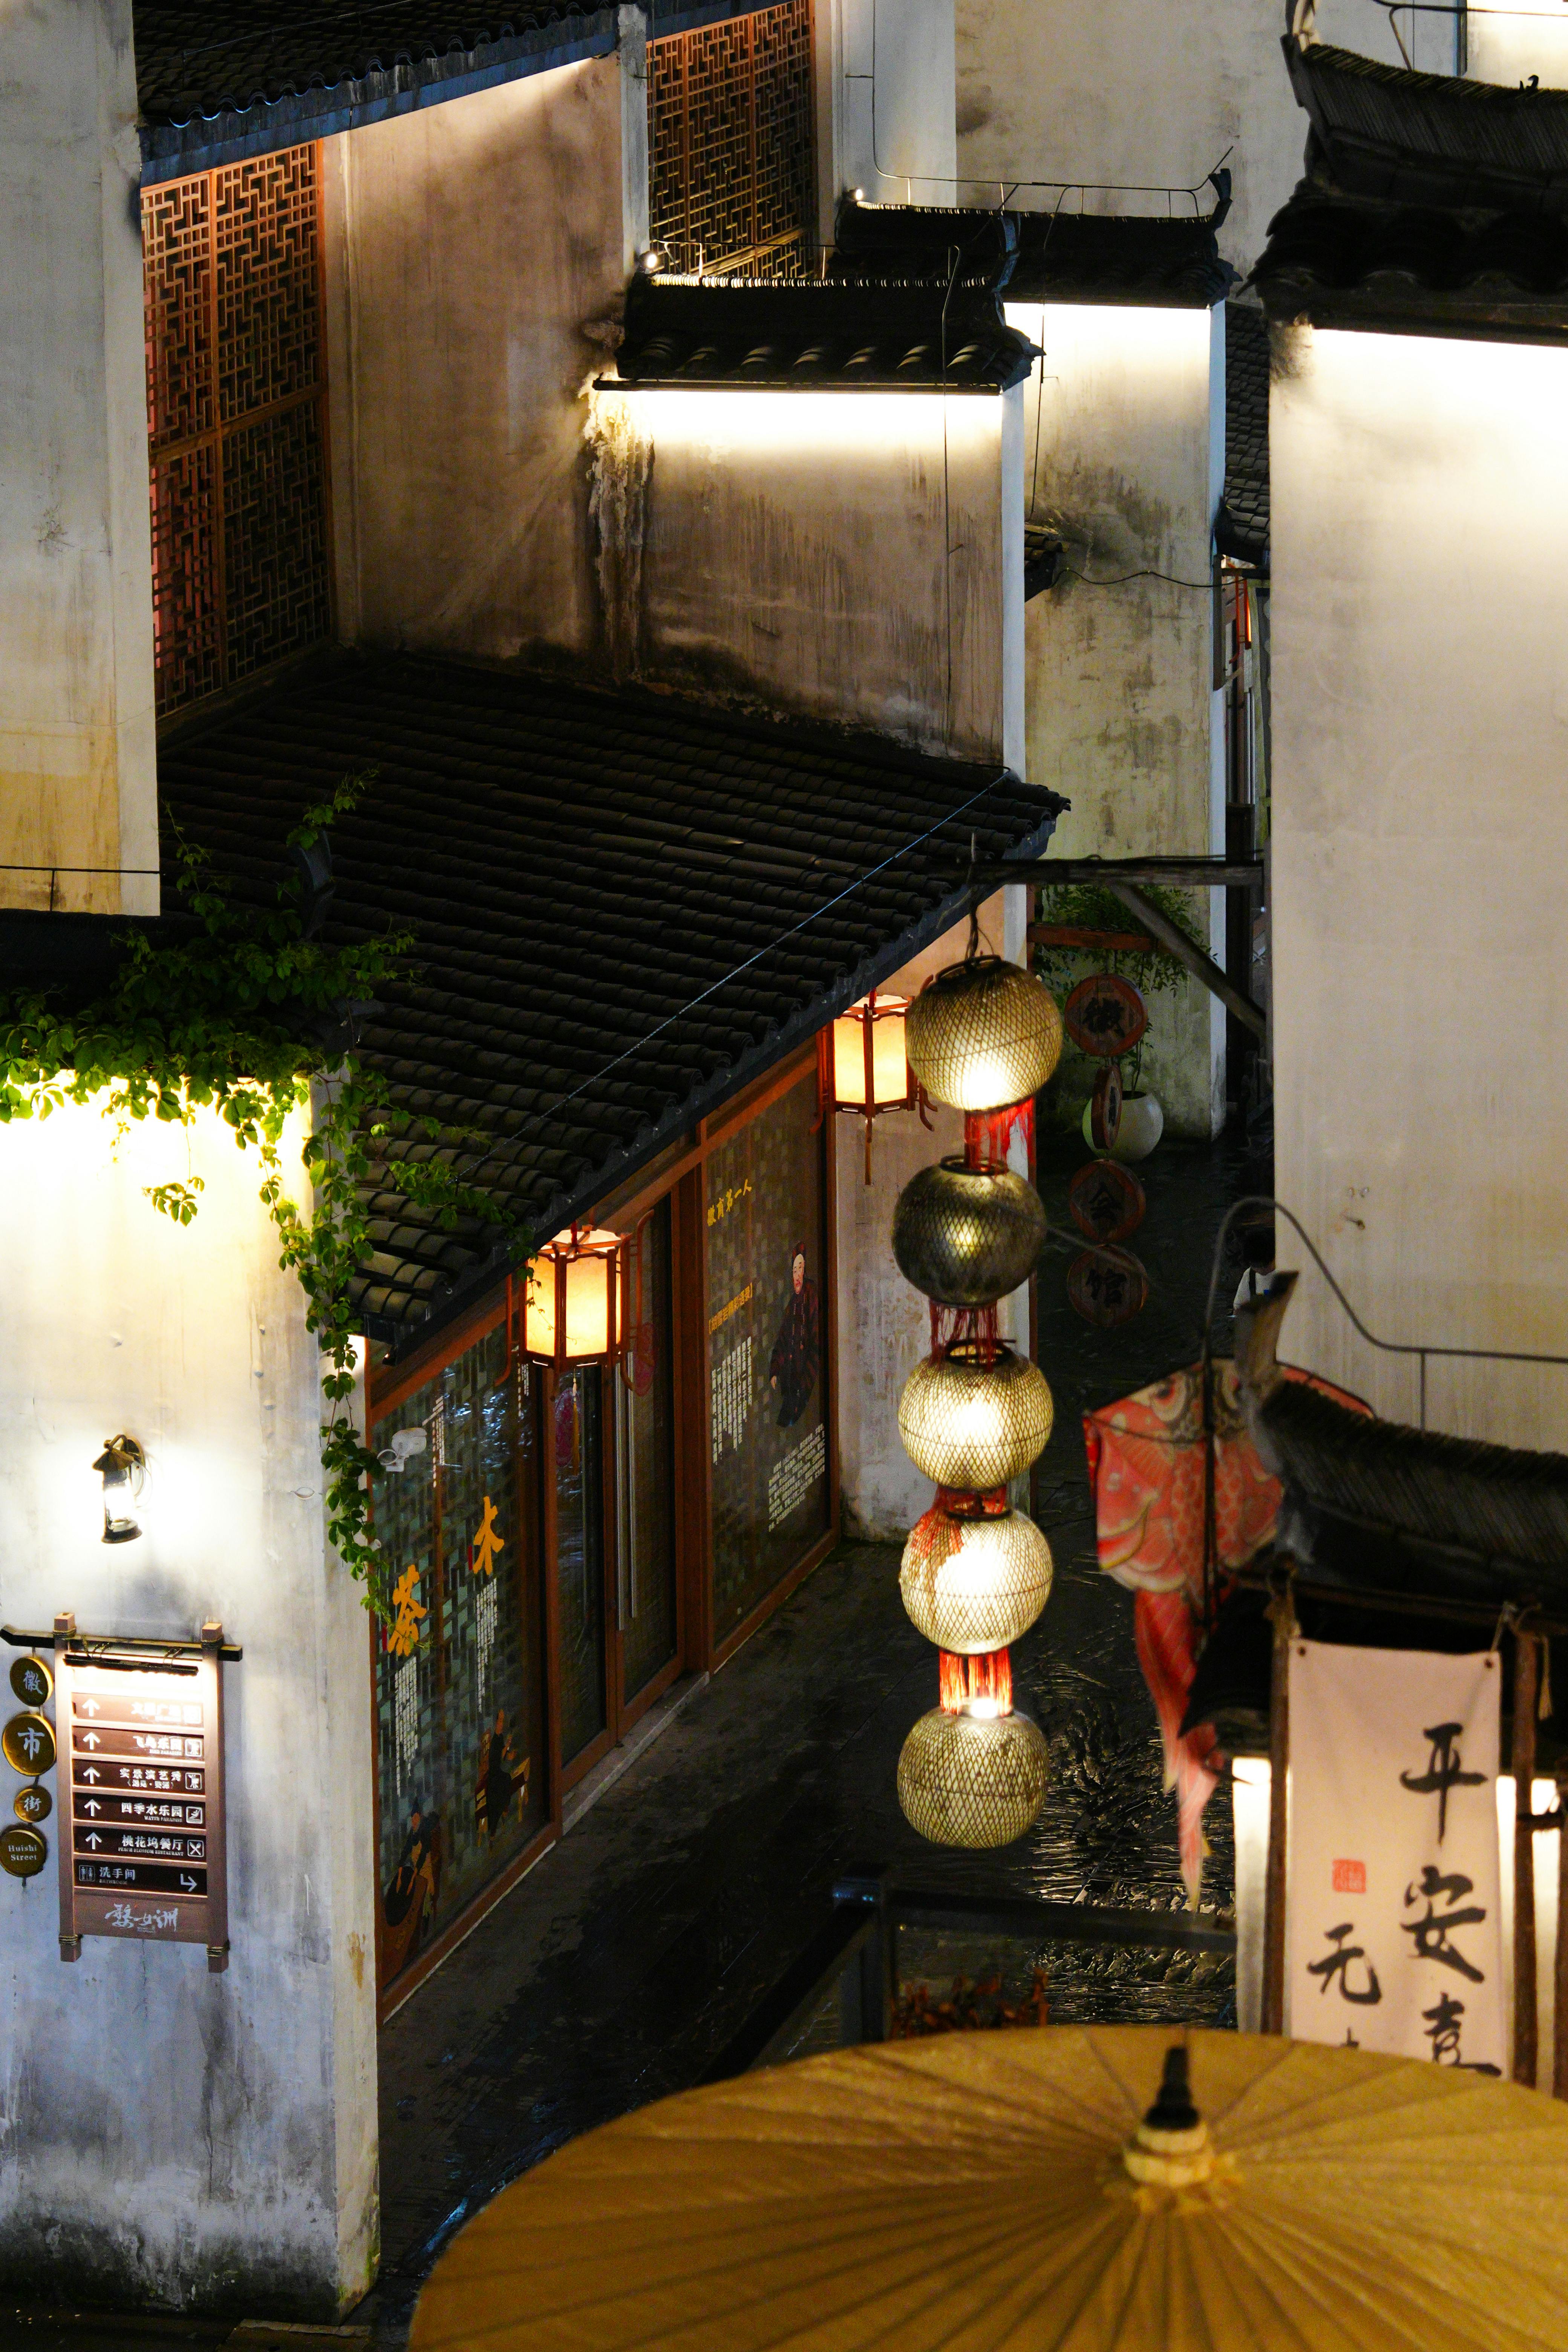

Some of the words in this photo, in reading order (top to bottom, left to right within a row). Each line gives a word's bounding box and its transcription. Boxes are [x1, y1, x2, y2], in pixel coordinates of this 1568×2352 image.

[387, 1564, 427, 1656] 茶
[119, 1767, 181, 1781] 实景演艺秀
[121, 1802, 182, 1817] 四季水乐园
[121, 1834, 183, 1851] 桃花坞餐厅
[99, 1866, 136, 1880] 洗手间
